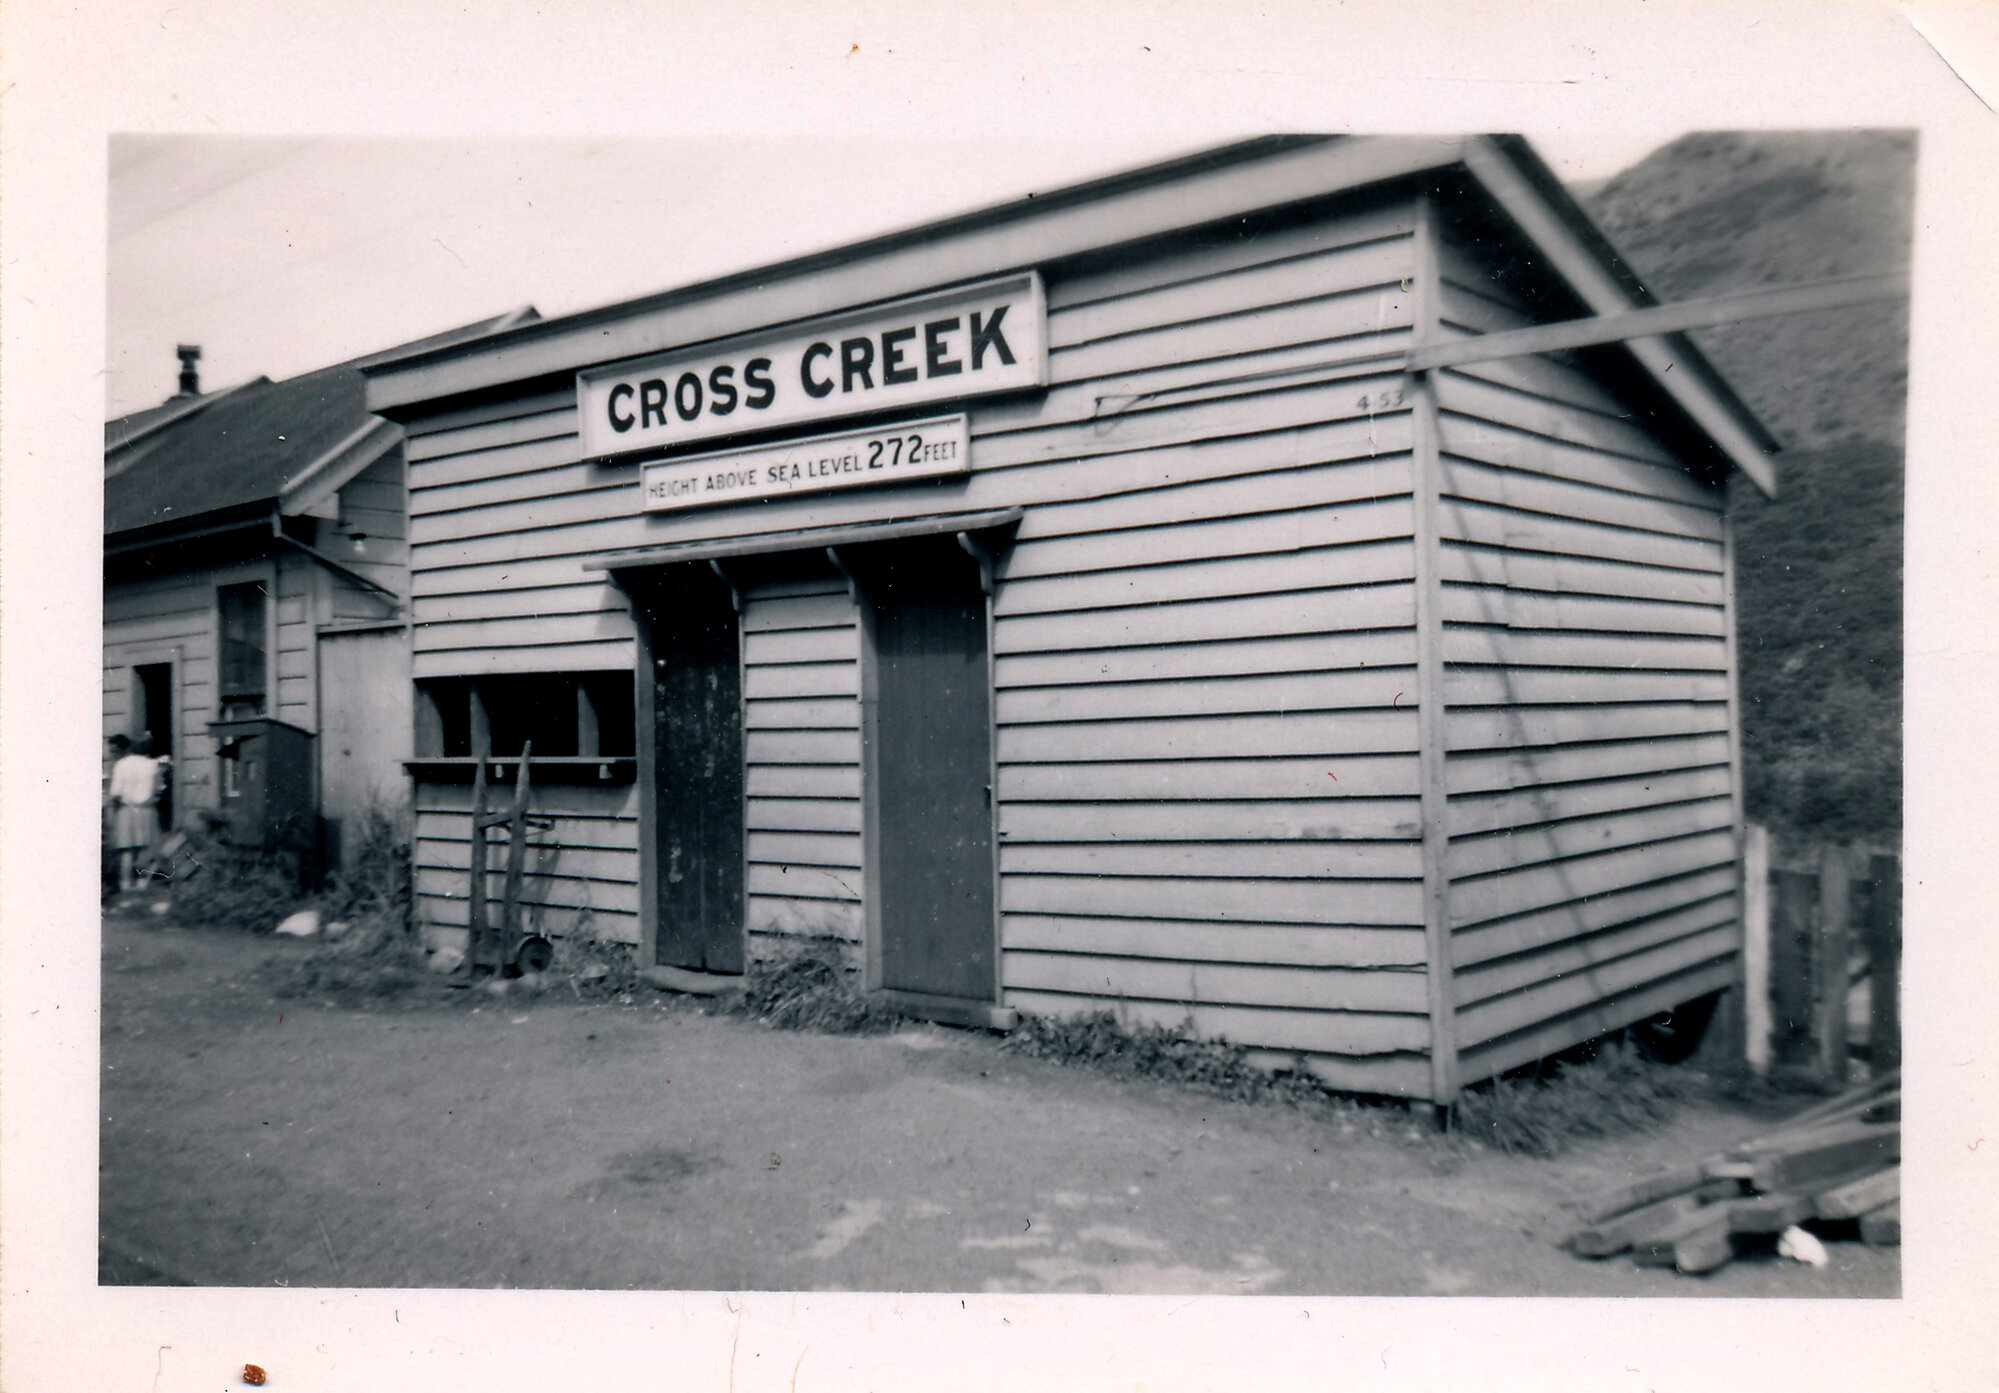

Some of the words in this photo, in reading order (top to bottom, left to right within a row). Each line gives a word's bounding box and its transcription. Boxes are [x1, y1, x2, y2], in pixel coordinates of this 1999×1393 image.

[608, 358, 775, 433] CROSS
[801, 305, 1017, 398] CREEK
[649, 477, 698, 498] HEIGHT
[705, 470, 757, 490] ABOVE
[767, 465, 800, 482] SEA
[809, 454, 863, 477] LEVEL
[868, 434, 923, 469] 272
[924, 441, 957, 462] FEET
